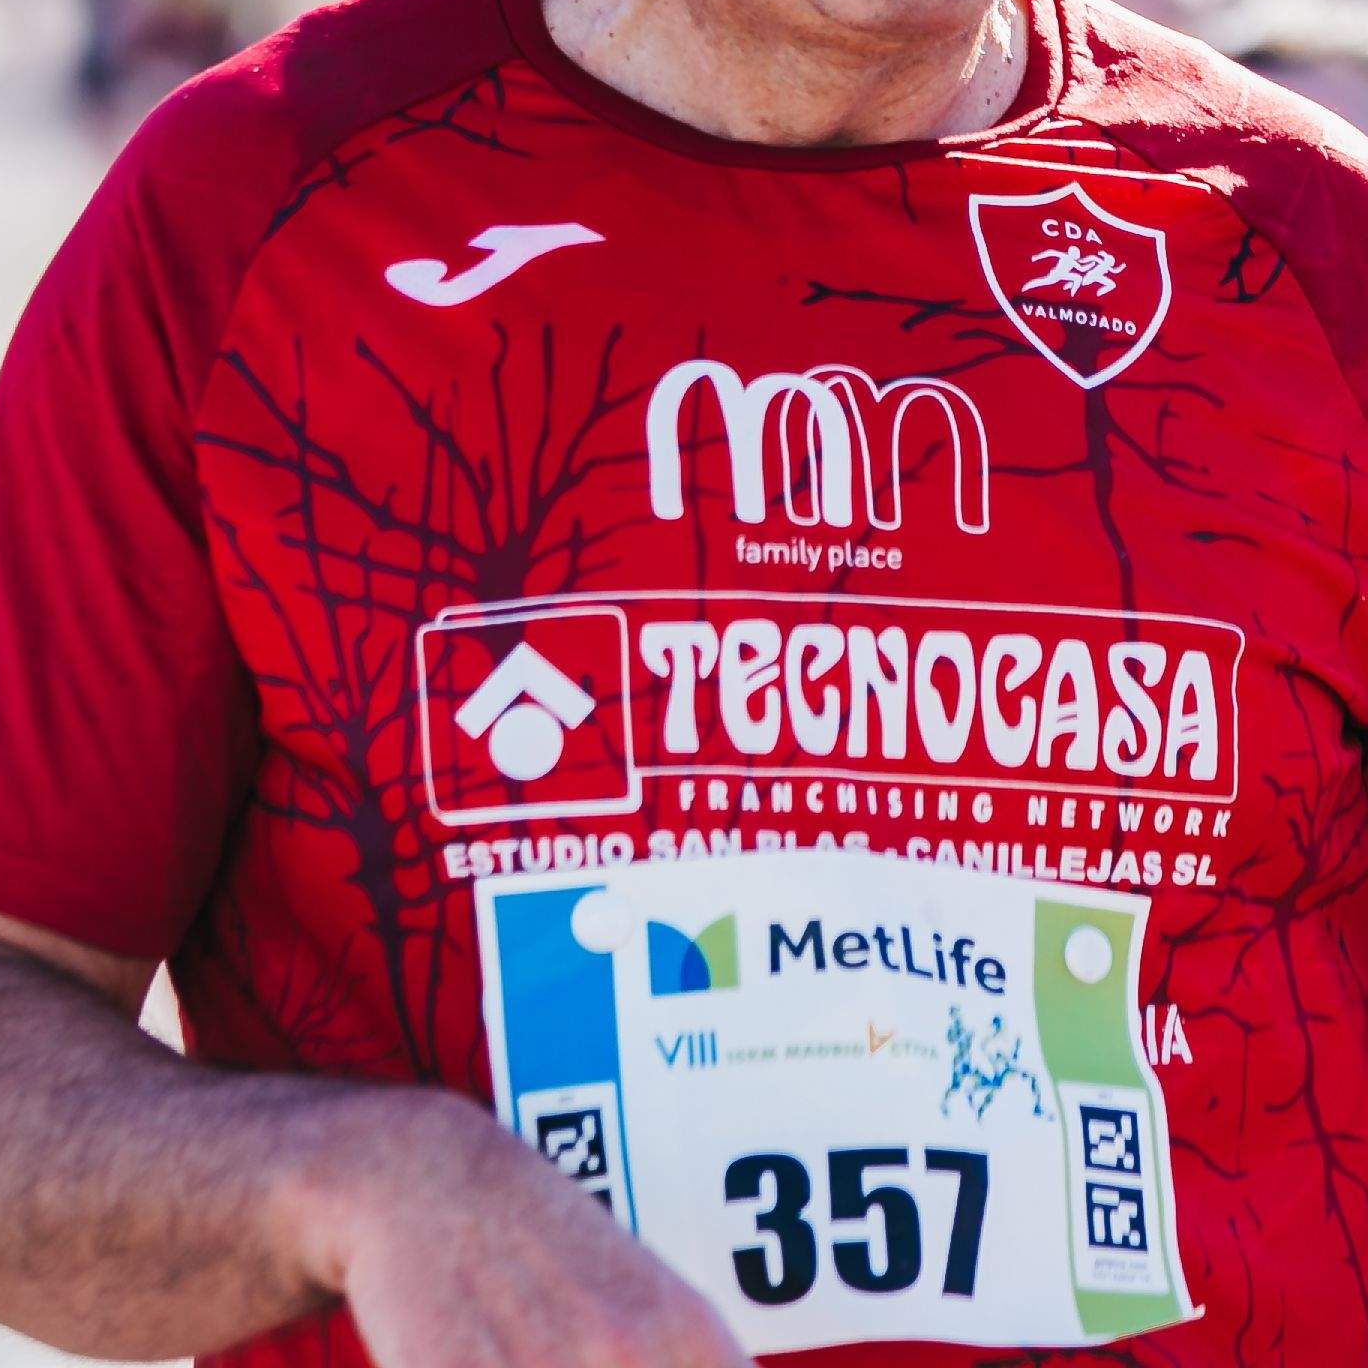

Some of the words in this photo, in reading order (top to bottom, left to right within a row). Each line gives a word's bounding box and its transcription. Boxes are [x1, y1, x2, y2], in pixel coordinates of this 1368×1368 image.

[1041, 218, 1104, 246] CDA
[1021, 303, 1138, 336] VALMOJADO
[734, 535, 823, 571] family
[827, 538, 904, 572] place
[639, 619, 1220, 781] TECNOCASA
[679, 779, 993, 824] FRANCHISING
[1027, 794, 1234, 838] NETWORK
[443, 832, 635, 880] ESTUDIO
[647, 828, 742, 862] SAN
[905, 836, 1164, 886] CANILLEJAS
[1170, 853, 1217, 887] SL
[768, 919, 1007, 997] MetLife
[654, 1030, 719, 1069] VIII
[722, 1143, 991, 1309] 357
